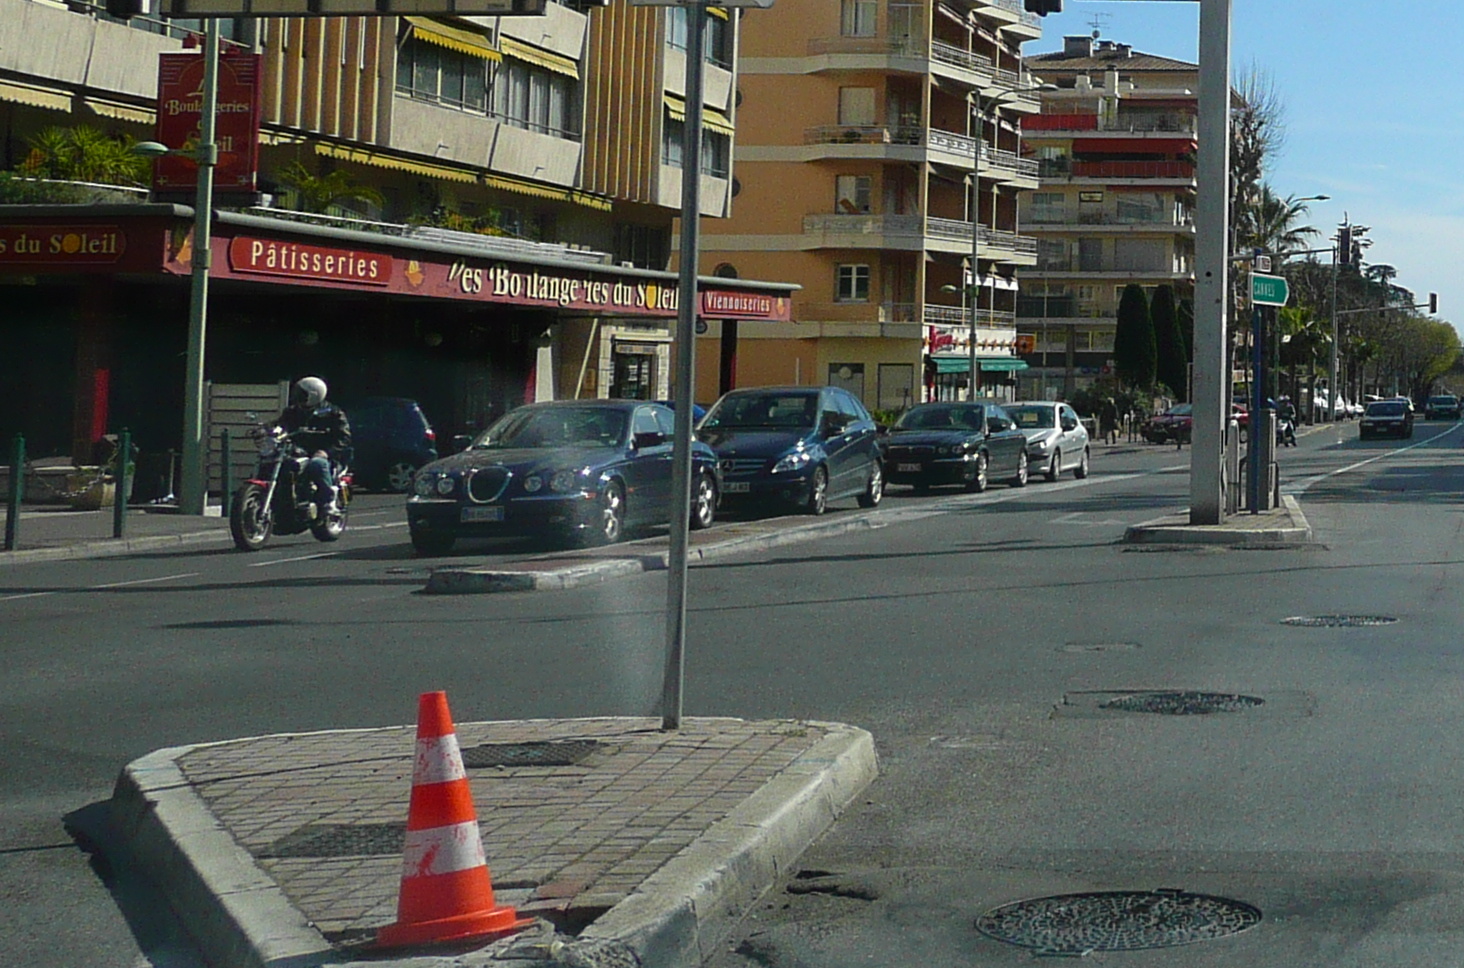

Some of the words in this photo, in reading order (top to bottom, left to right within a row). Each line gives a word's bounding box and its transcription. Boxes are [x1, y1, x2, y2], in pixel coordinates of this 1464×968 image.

[14, 233, 41, 254] du
[49, 232, 117, 254] Soleil
[250, 240, 378, 278] Pâtisseries
[613, 279, 631, 306] du
[706, 291, 770, 312] Viennoiseries
